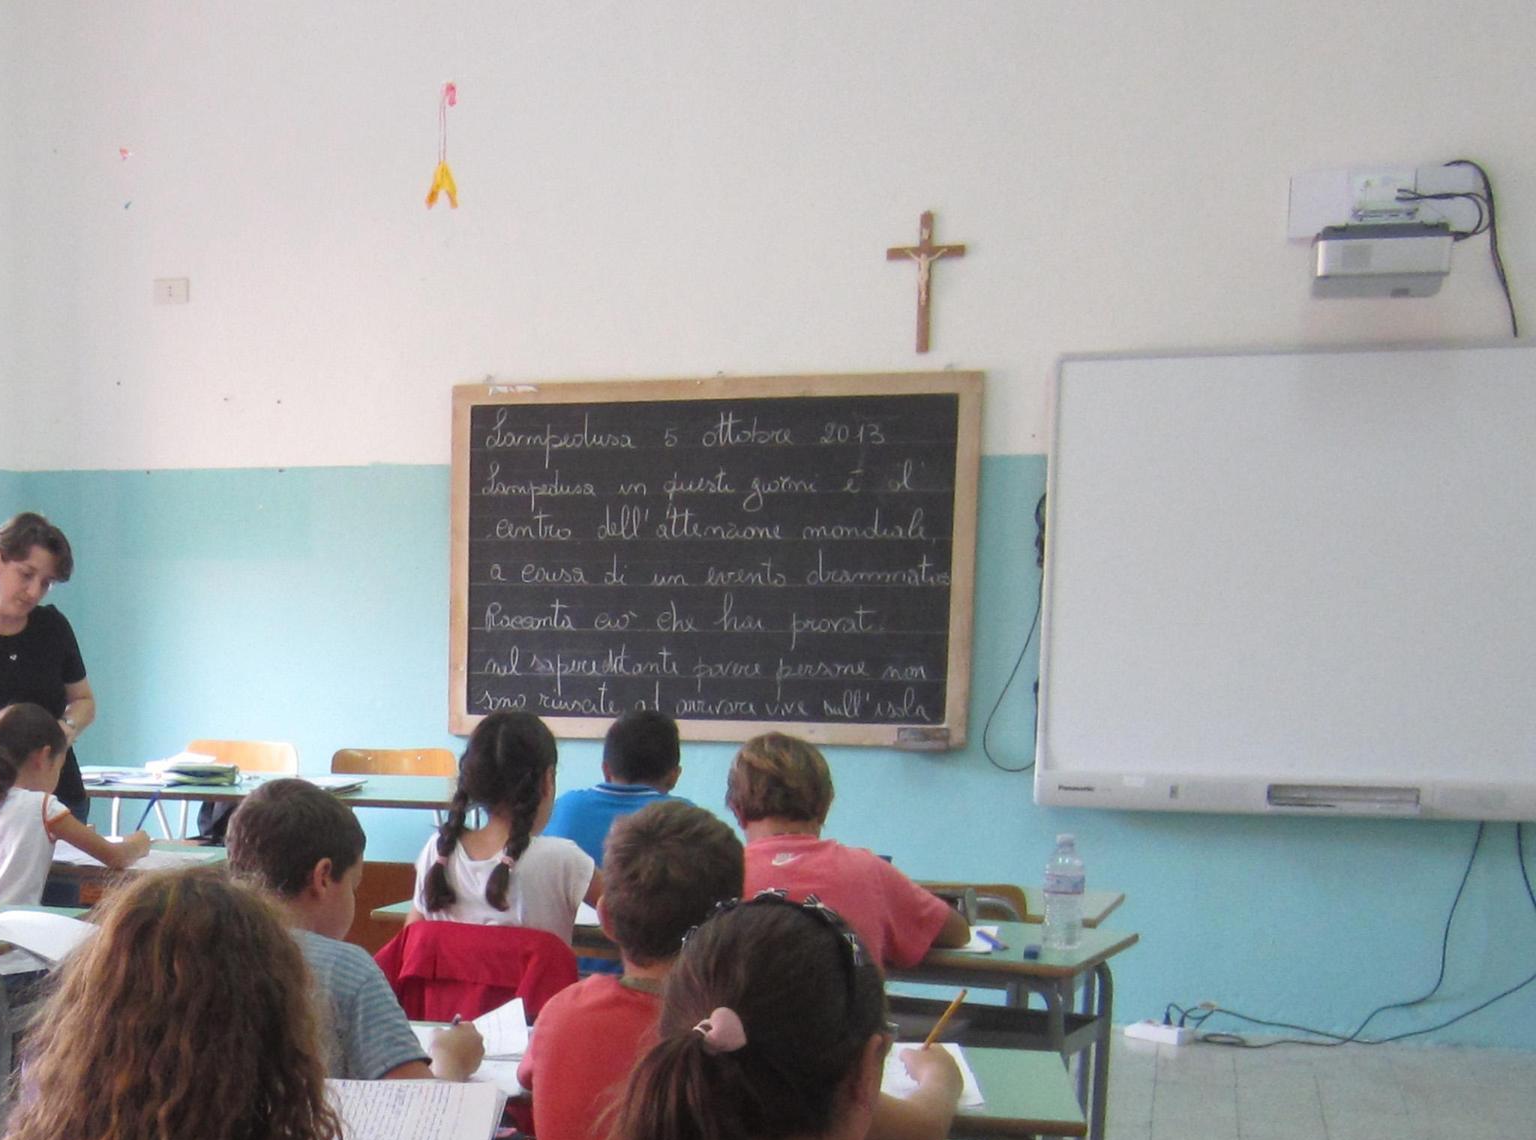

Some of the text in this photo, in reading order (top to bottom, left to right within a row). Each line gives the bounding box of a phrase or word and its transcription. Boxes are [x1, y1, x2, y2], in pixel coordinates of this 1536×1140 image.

[485, 408, 888, 470] Lampedusa 5 ottobre 2013
[481, 460, 597, 513] Lampedusa
[617, 480, 648, 497] in
[662, 466, 736, 502] questi
[742, 473, 818, 513] giorni
[489, 563, 508, 584] a
[521, 563, 590, 586] causa
[603, 552, 628, 586] di
[651, 571, 689, 587] un
[704, 556, 787, 588] evento
[484, 598, 577, 633] Racconta
[656, 600, 698, 632] che
[712, 591, 767, 632] hai
[484, 645, 523, 677] nel
[692, 656, 763, 694] povere
[775, 657, 871, 701] persone
[881, 665, 928, 681] non
[765, 699, 810, 717] vive
